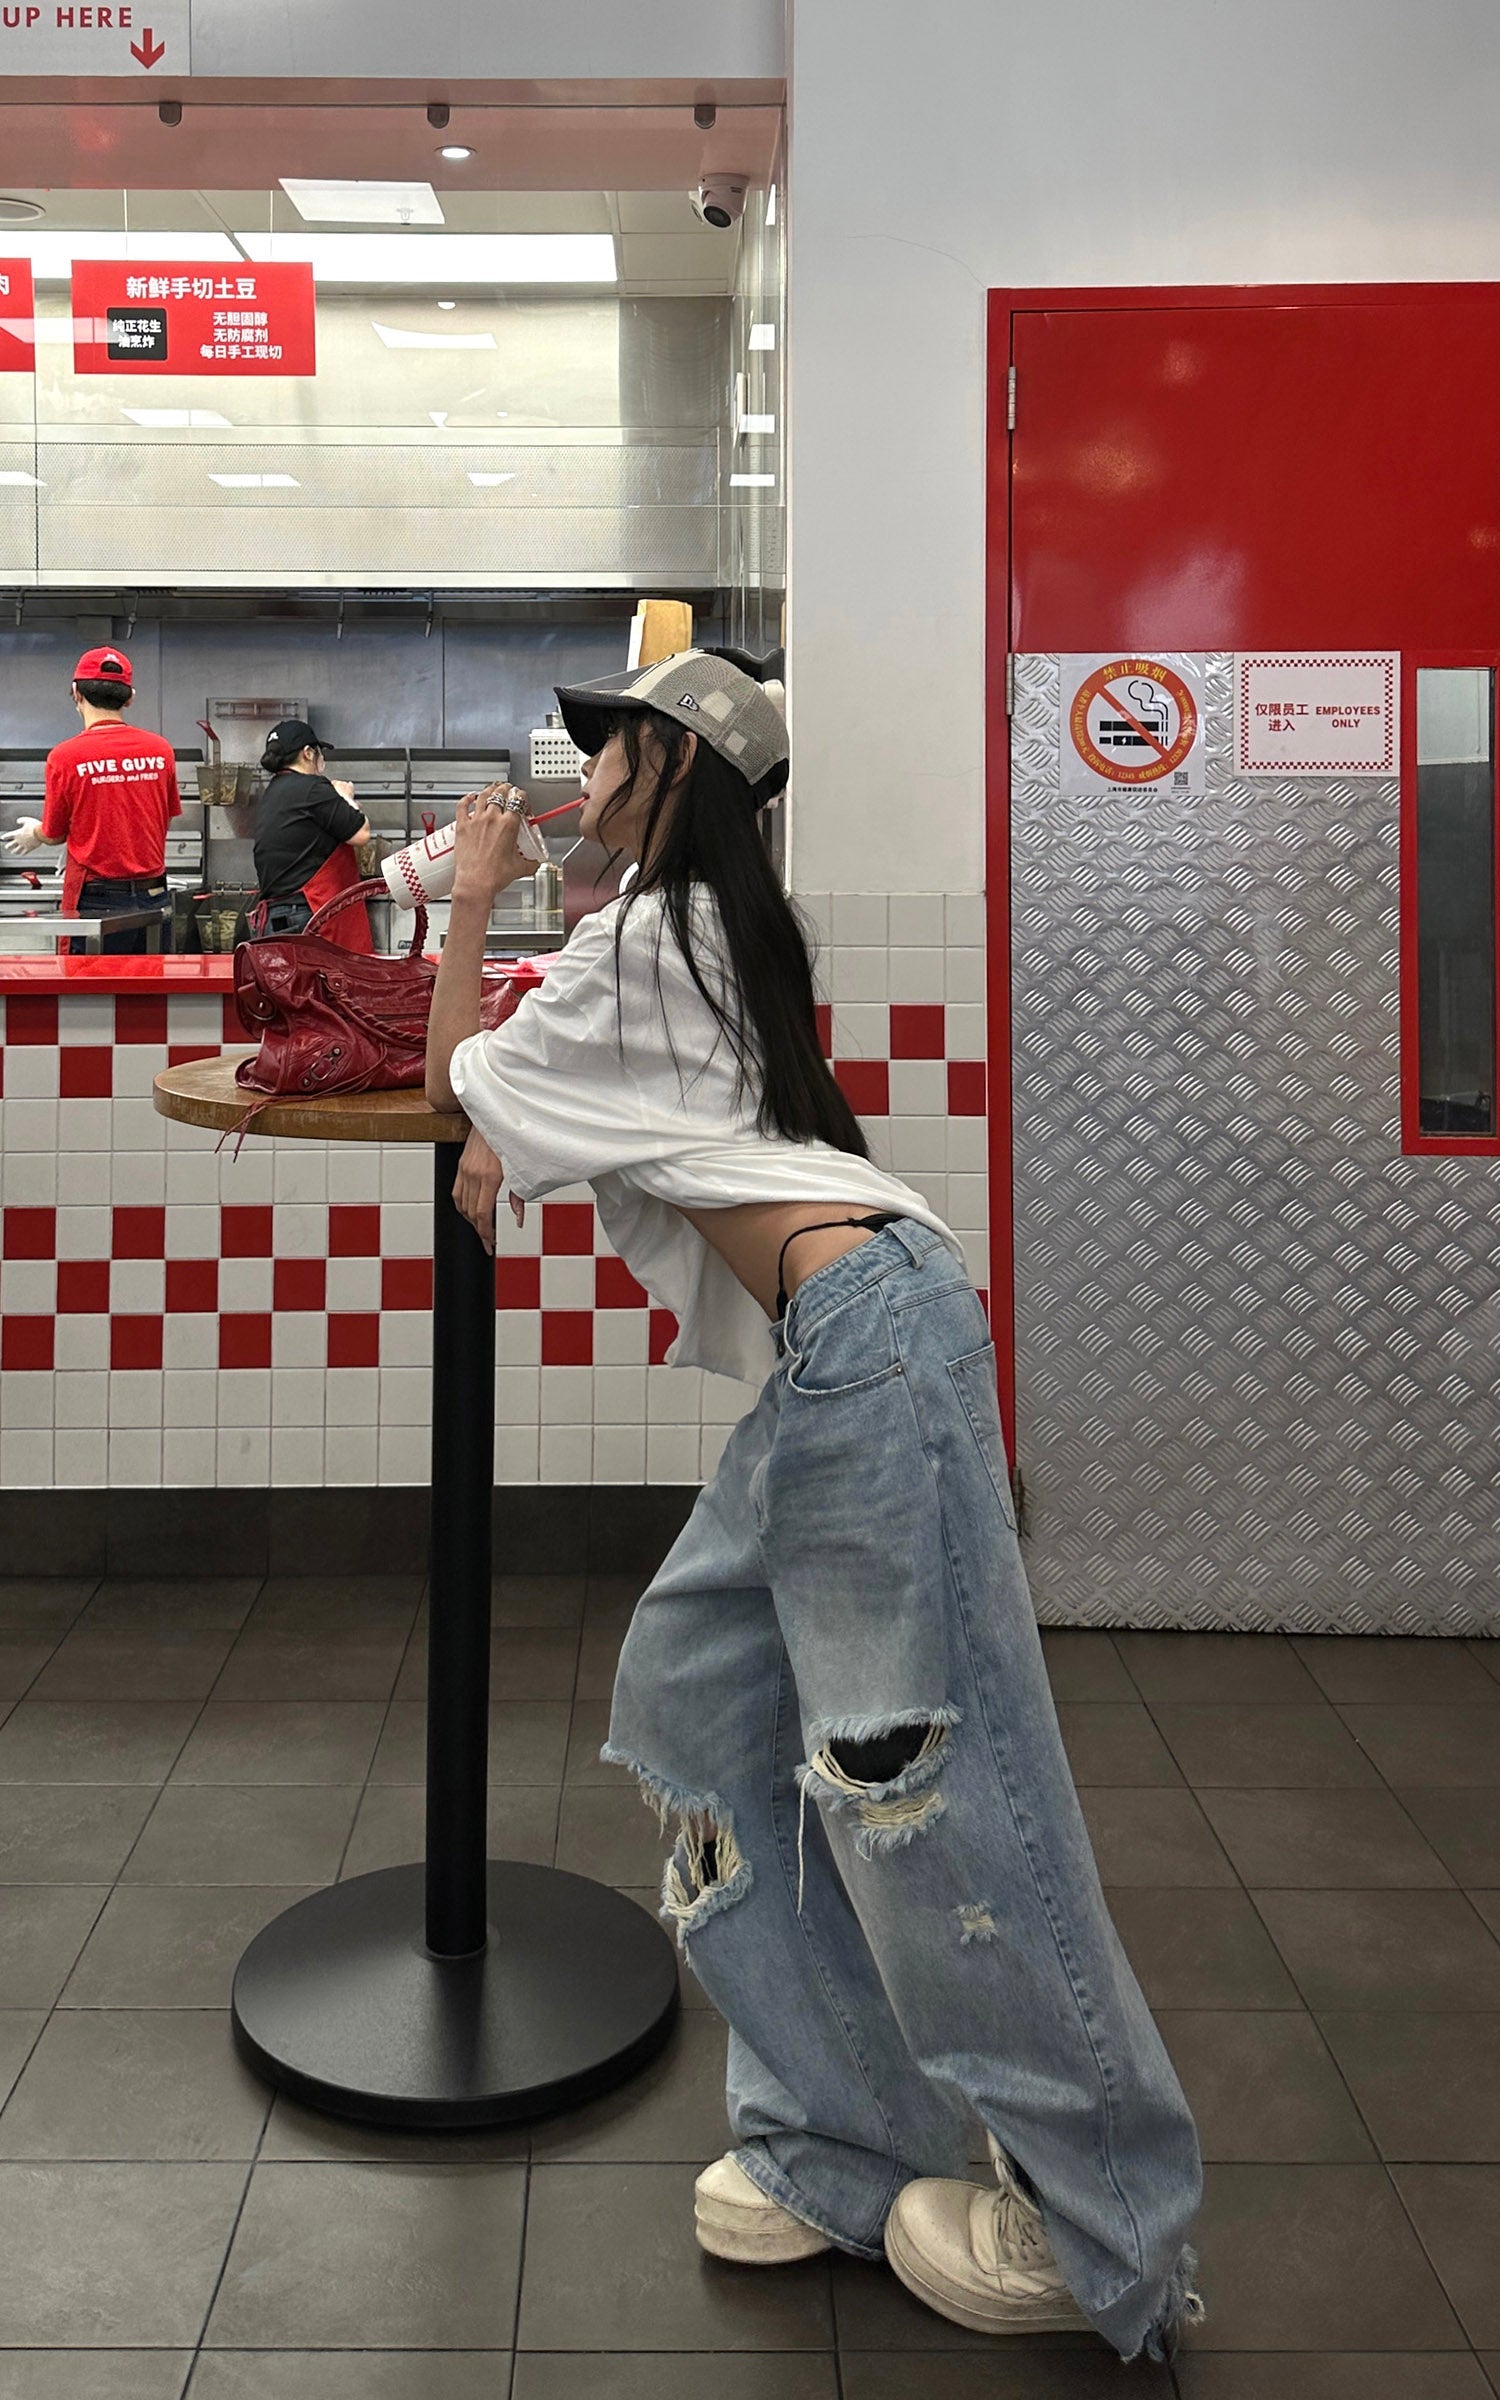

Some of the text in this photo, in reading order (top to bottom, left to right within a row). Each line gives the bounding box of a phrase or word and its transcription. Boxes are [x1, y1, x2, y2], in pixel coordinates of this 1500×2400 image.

[3, 6, 132, 28] UP HERE
[126, 276, 257, 299] 新鲜手切土豆
[112, 319, 162, 333] 纯正花生
[213, 311, 268, 327] 无胆固醇
[213, 328, 269, 342] 无防腐剂
[200, 344, 282, 359] 每日手工现切
[1103, 662, 1167, 682] 禁止吸烟
[1255, 703, 1309, 716] 仅限员工
[1315, 706, 1381, 715] EMPLOYEES
[1268, 719, 1295, 732] 进入
[1332, 719, 1360, 728] ONLY
[76, 756, 165, 777] FIVE GUYS
